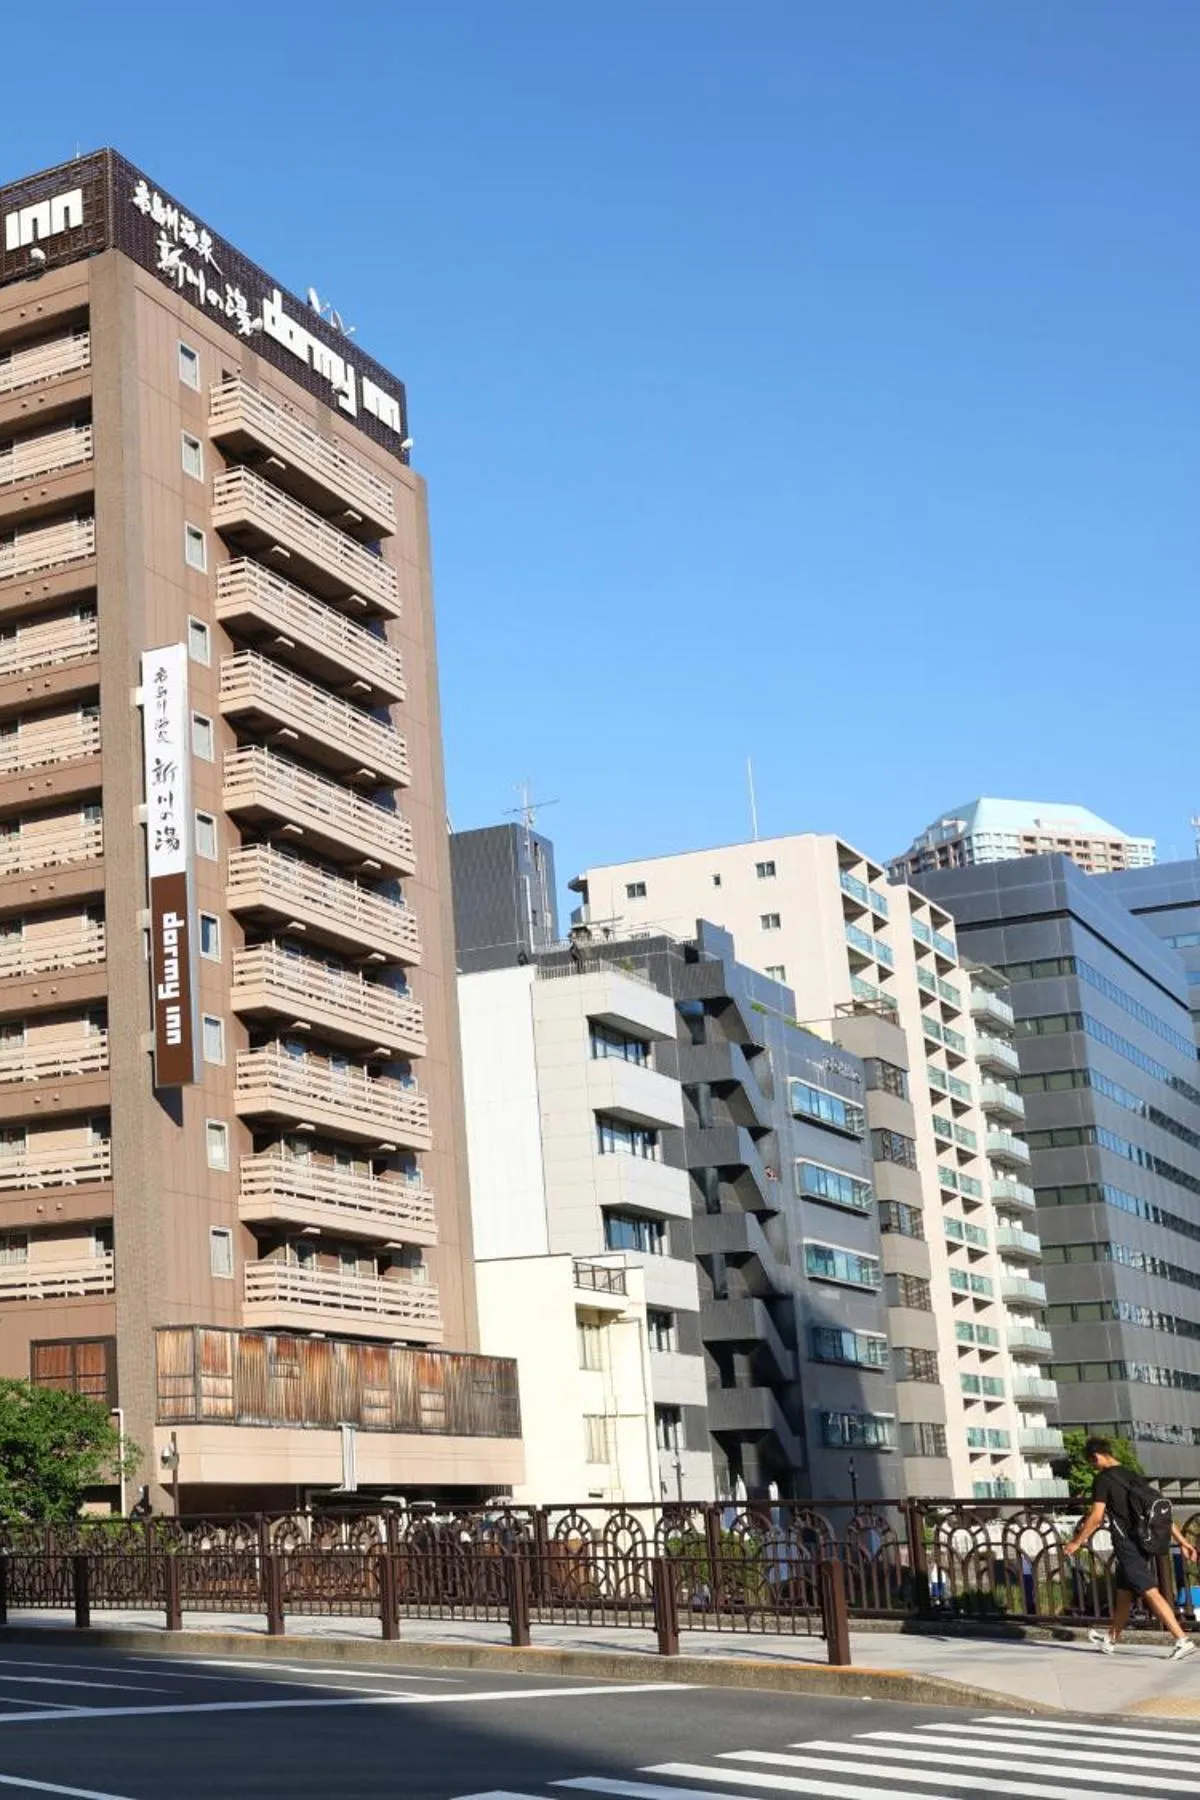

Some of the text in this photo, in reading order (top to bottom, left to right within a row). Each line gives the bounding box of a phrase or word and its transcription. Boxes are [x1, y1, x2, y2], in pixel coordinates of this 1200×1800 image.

[5, 188, 83, 251] inn
[262, 288, 401, 434] dormy inn
[157, 911, 185, 1046] dormy inn
